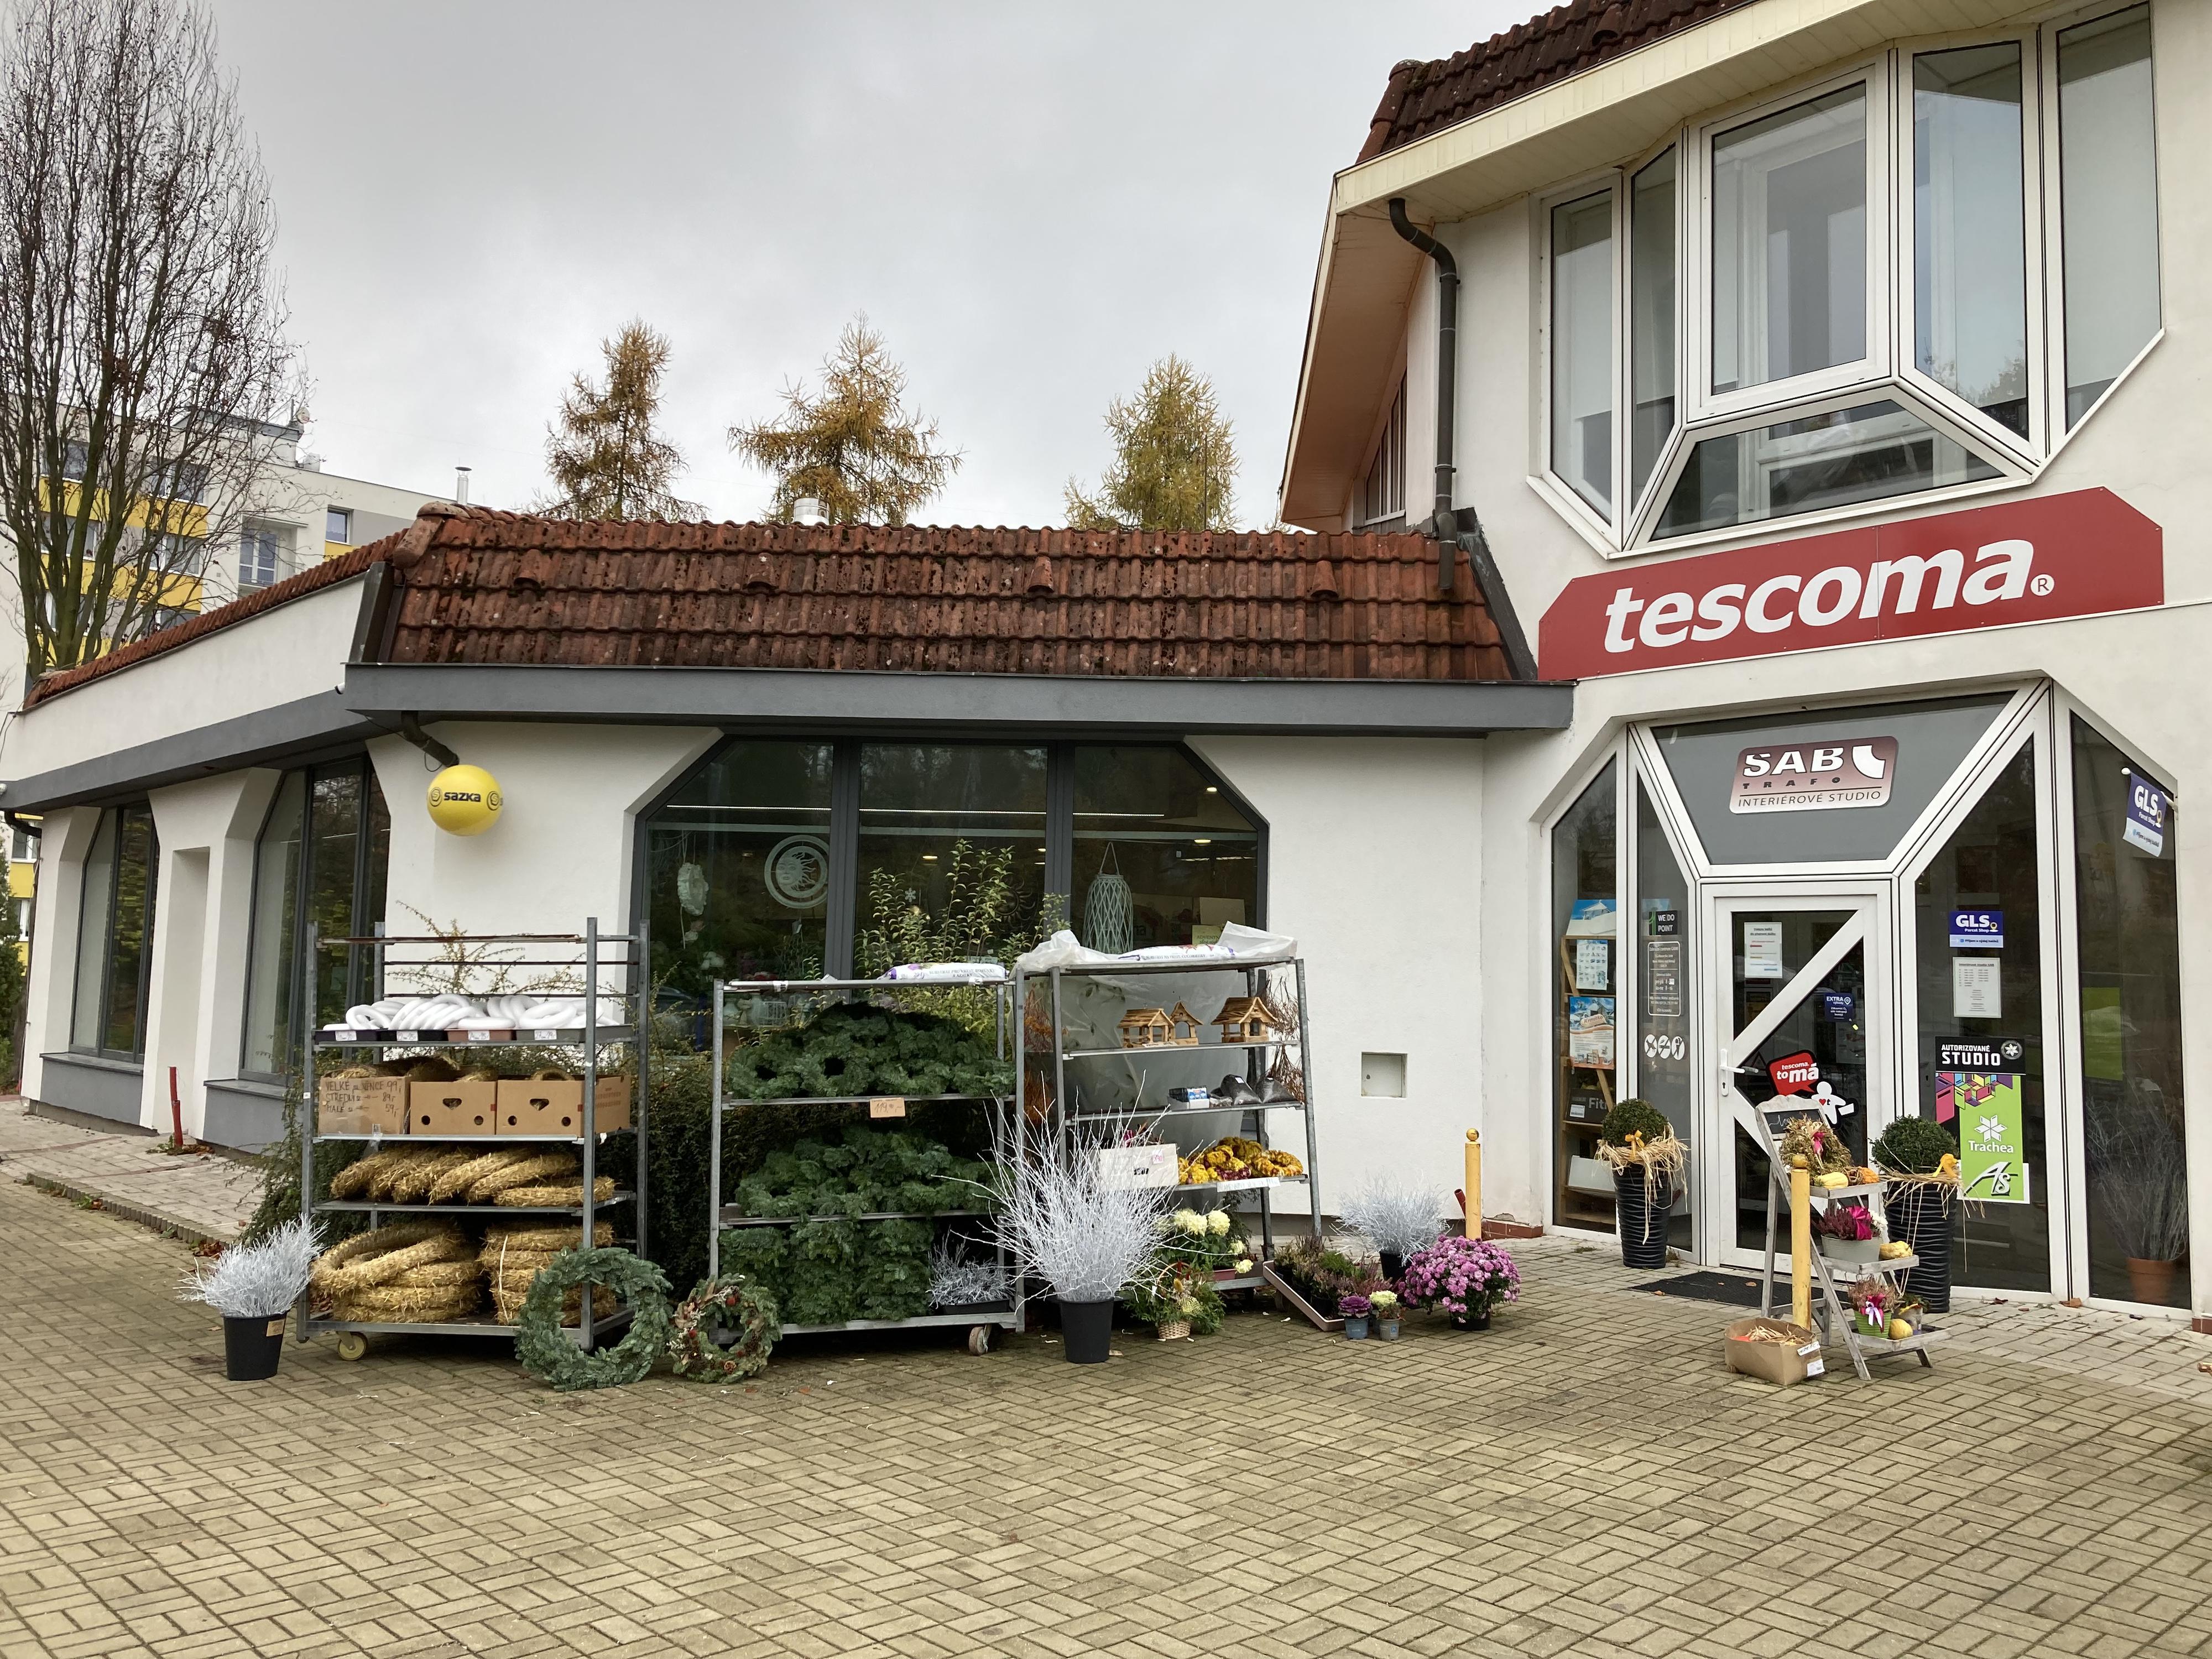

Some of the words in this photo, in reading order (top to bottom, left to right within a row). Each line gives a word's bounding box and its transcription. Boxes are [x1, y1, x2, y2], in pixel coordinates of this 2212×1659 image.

[1743, 747, 1844, 778] SAB
[444, 792, 481, 802] sazka
[1738, 792, 1823, 807] INTERIÉROVÉ
[1828, 791, 1881, 802] STUDIO
[2134, 785, 2158, 816] GLS
[1955, 915, 1990, 927] GLS
[1941, 1044, 1990, 1052] AUTORIZOVANÉ
[1942, 1051, 2001, 1066] STUDIO
[1776, 1070, 1788, 1080] to
[1788, 1062, 1819, 1083] má
[1968, 1140, 2014, 1153] Trachea
